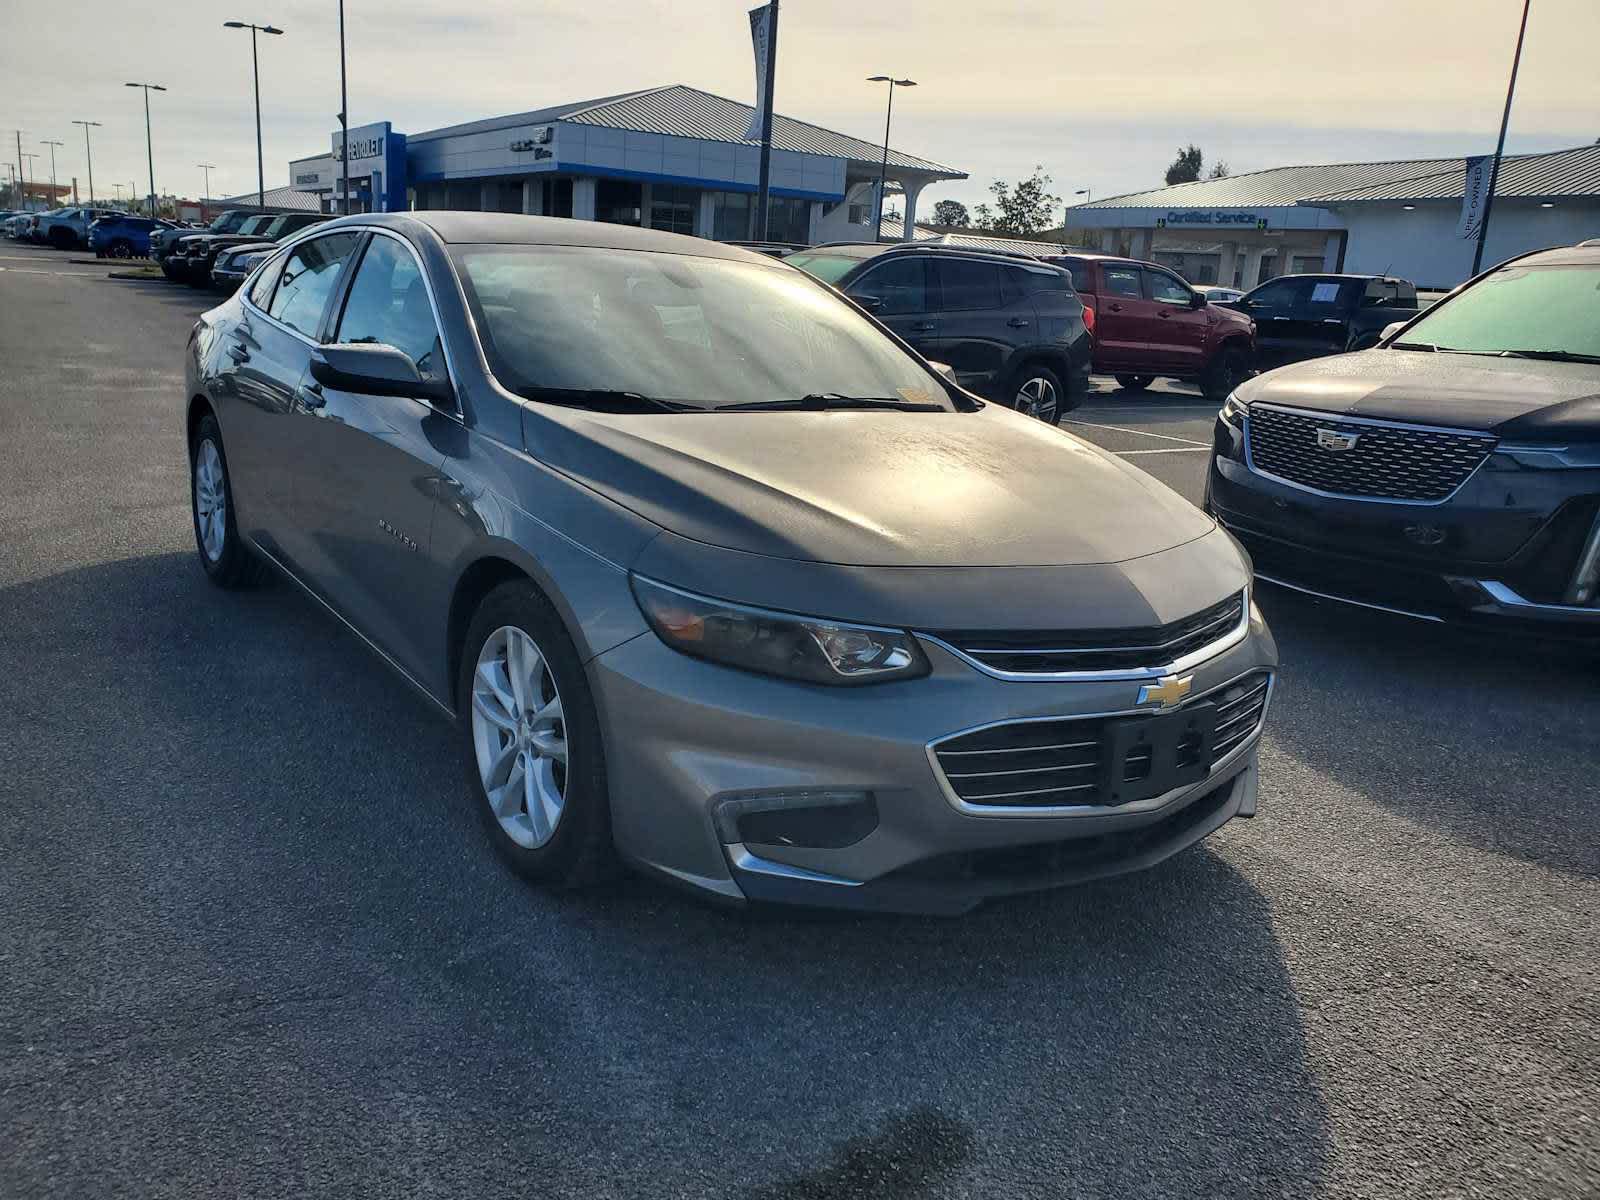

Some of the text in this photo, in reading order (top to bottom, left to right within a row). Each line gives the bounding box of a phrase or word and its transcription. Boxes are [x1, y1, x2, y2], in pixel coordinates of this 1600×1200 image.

[343, 137, 384, 160] HEVROLET
[1471, 167, 1482, 208] OWNED
[1167, 211, 1256, 223] Certified Service
